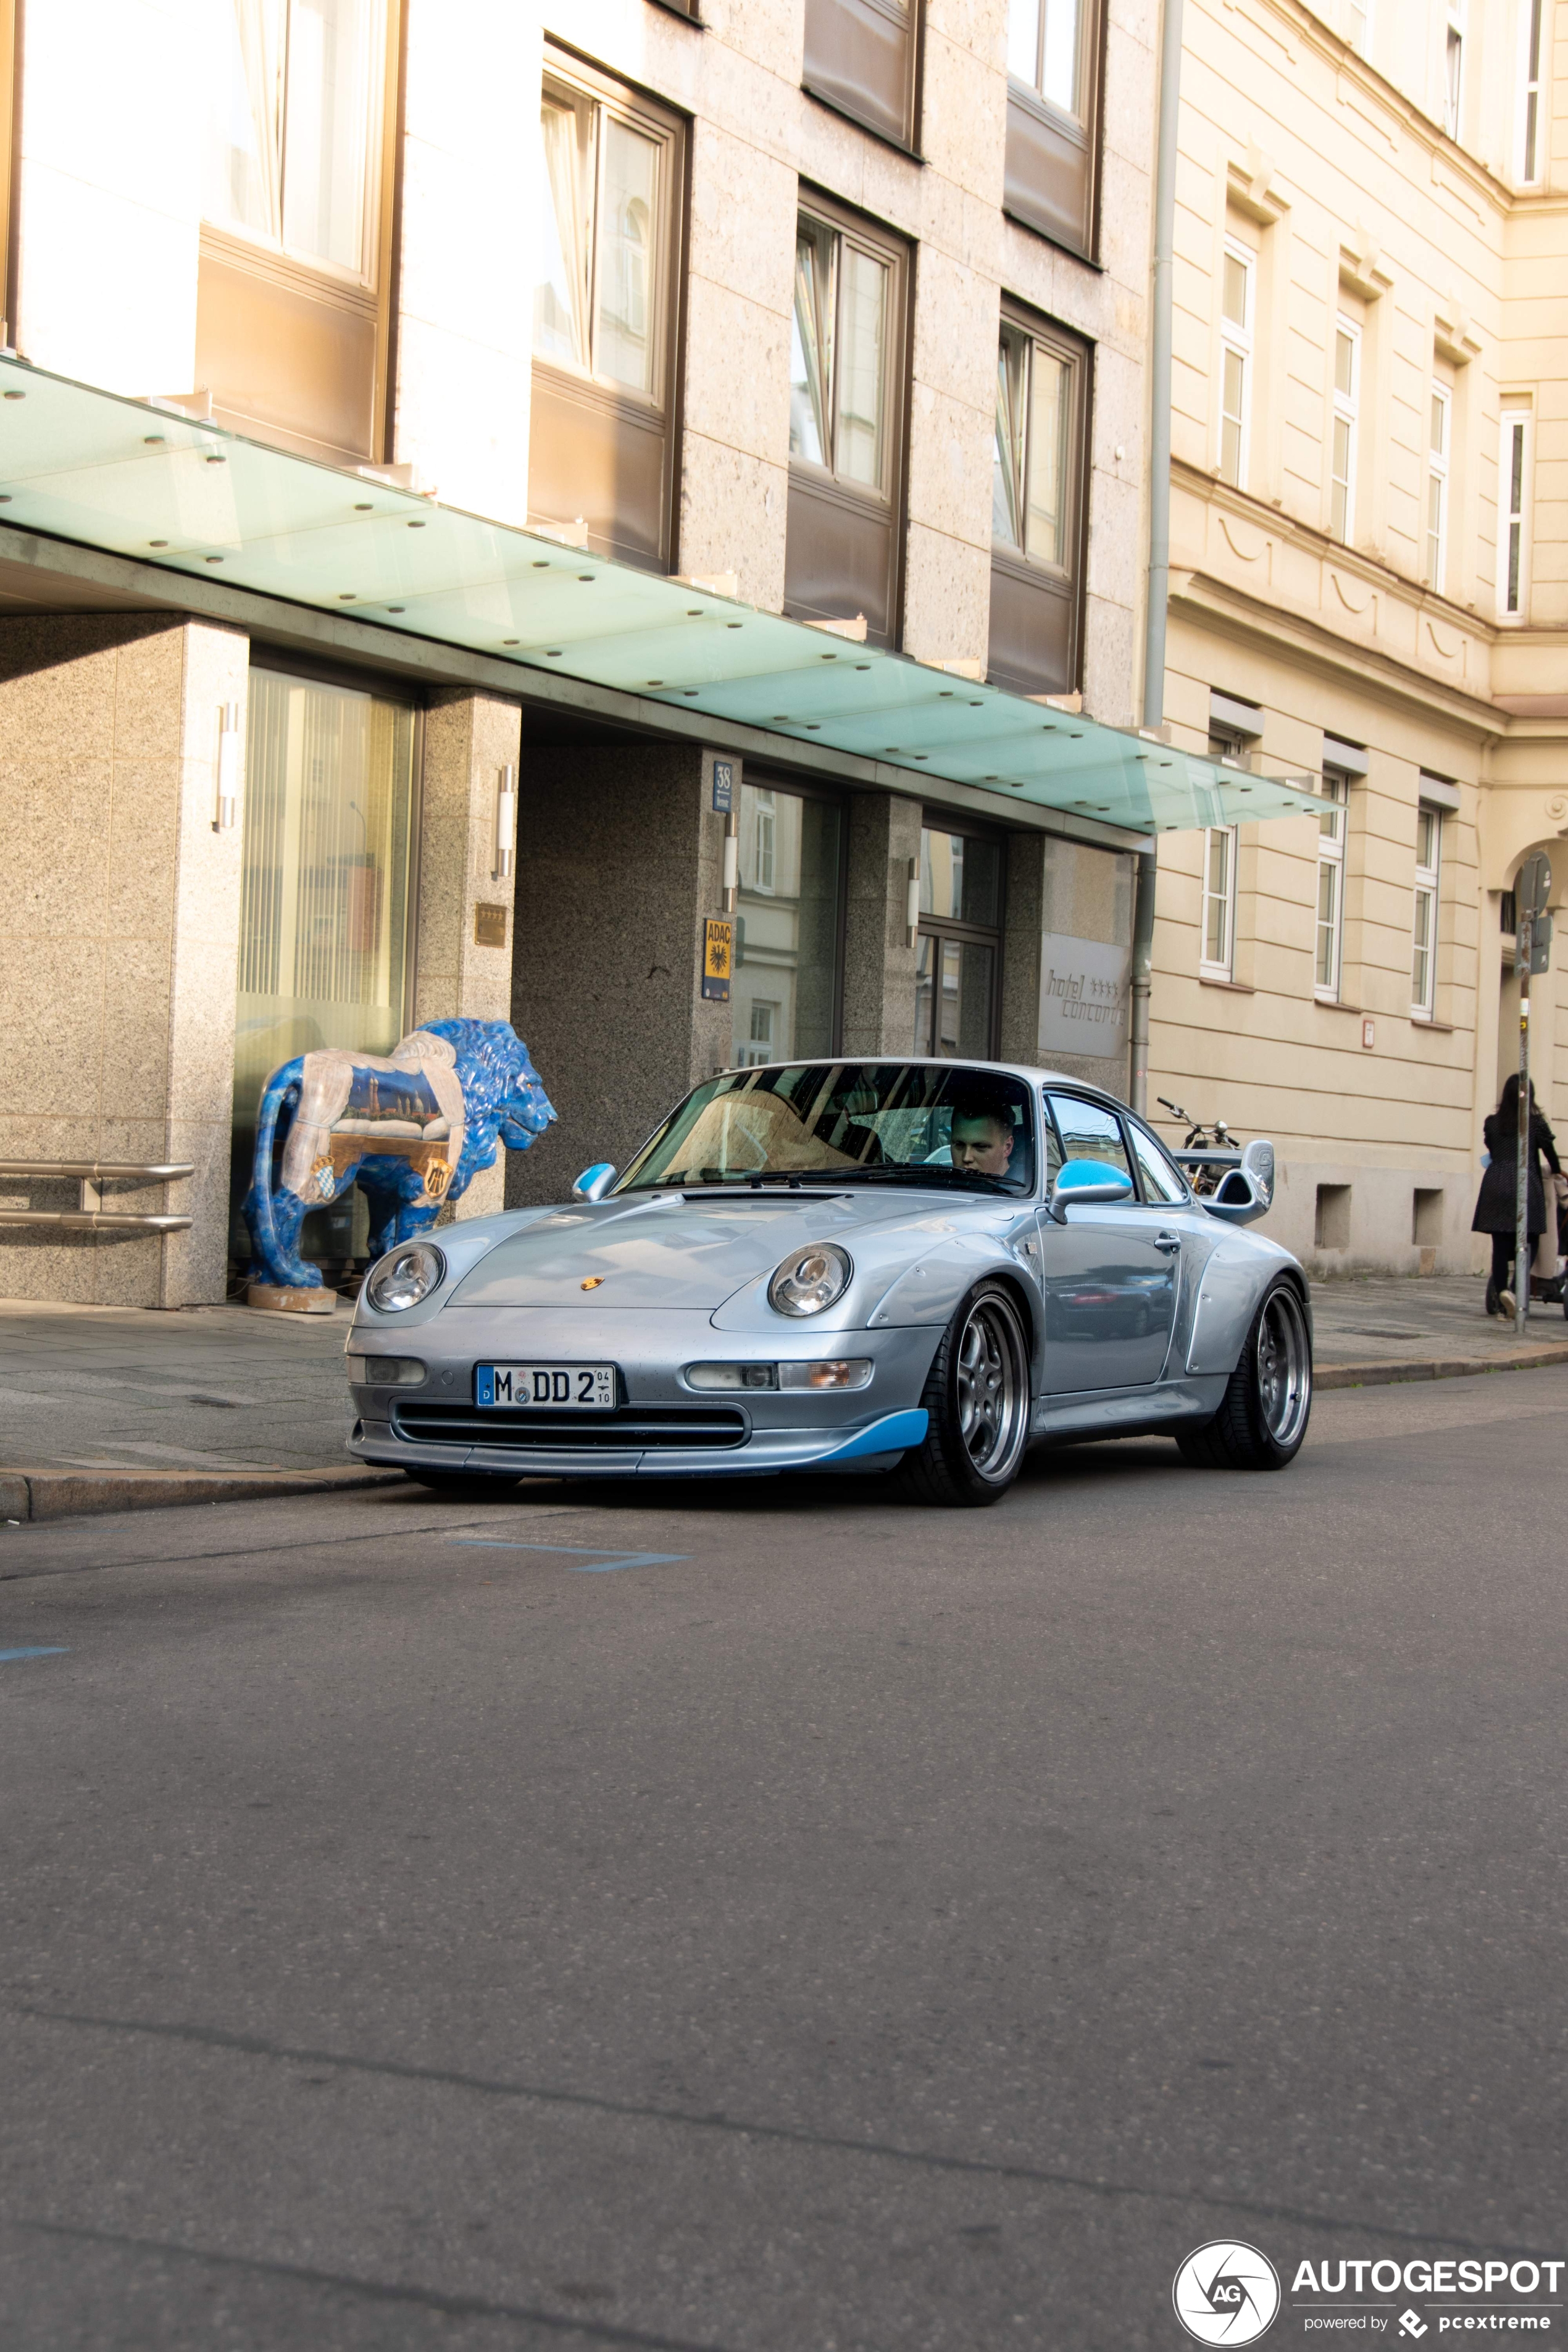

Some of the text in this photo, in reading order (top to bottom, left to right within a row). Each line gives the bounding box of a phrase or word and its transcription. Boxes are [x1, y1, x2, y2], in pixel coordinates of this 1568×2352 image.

[717, 766, 730, 789] 38
[708, 923, 730, 944] ADAC
[1046, 969, 1085, 1000] hotel
[1061, 999, 1126, 1026] concorde
[495, 1370, 594, 1402] M DD 2
[598, 1372, 609, 1380] 04
[483, 1390, 490, 1399] D
[599, 1393, 609, 1403] 10
